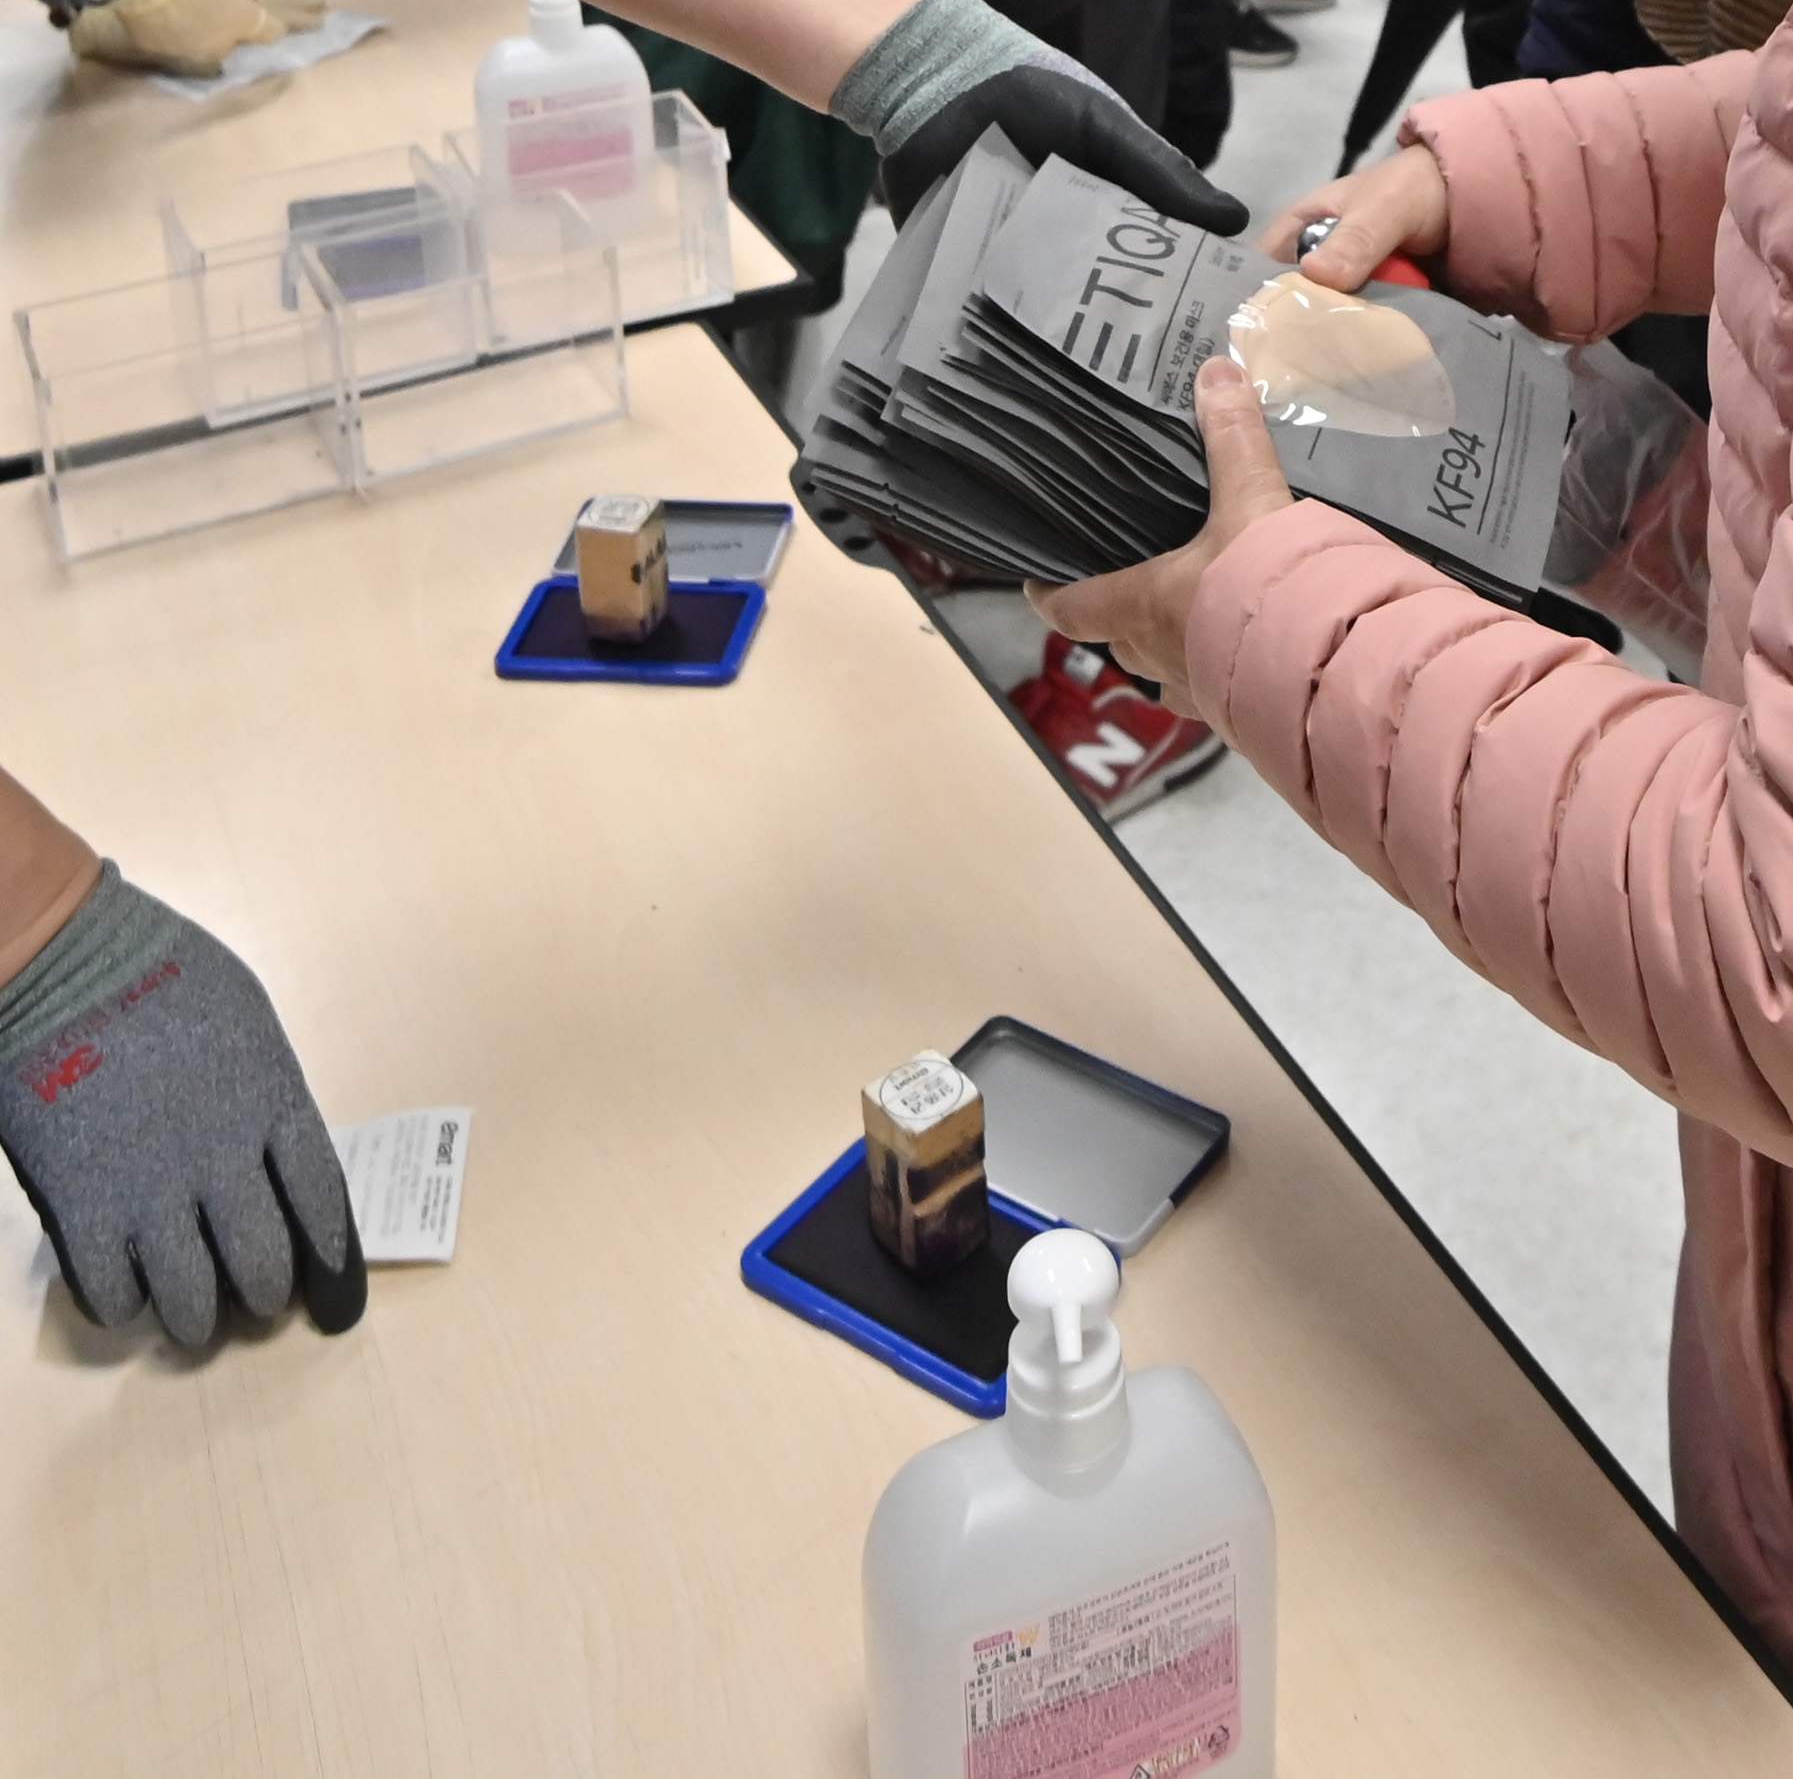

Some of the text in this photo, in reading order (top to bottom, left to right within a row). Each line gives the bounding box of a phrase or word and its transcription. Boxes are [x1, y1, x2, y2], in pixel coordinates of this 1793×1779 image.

[1170, 330, 1194, 368] 보건용
[1185, 300, 1205, 324] 마스크
[1426, 426, 1486, 528] KF94
[1066, 721, 1147, 789] N
